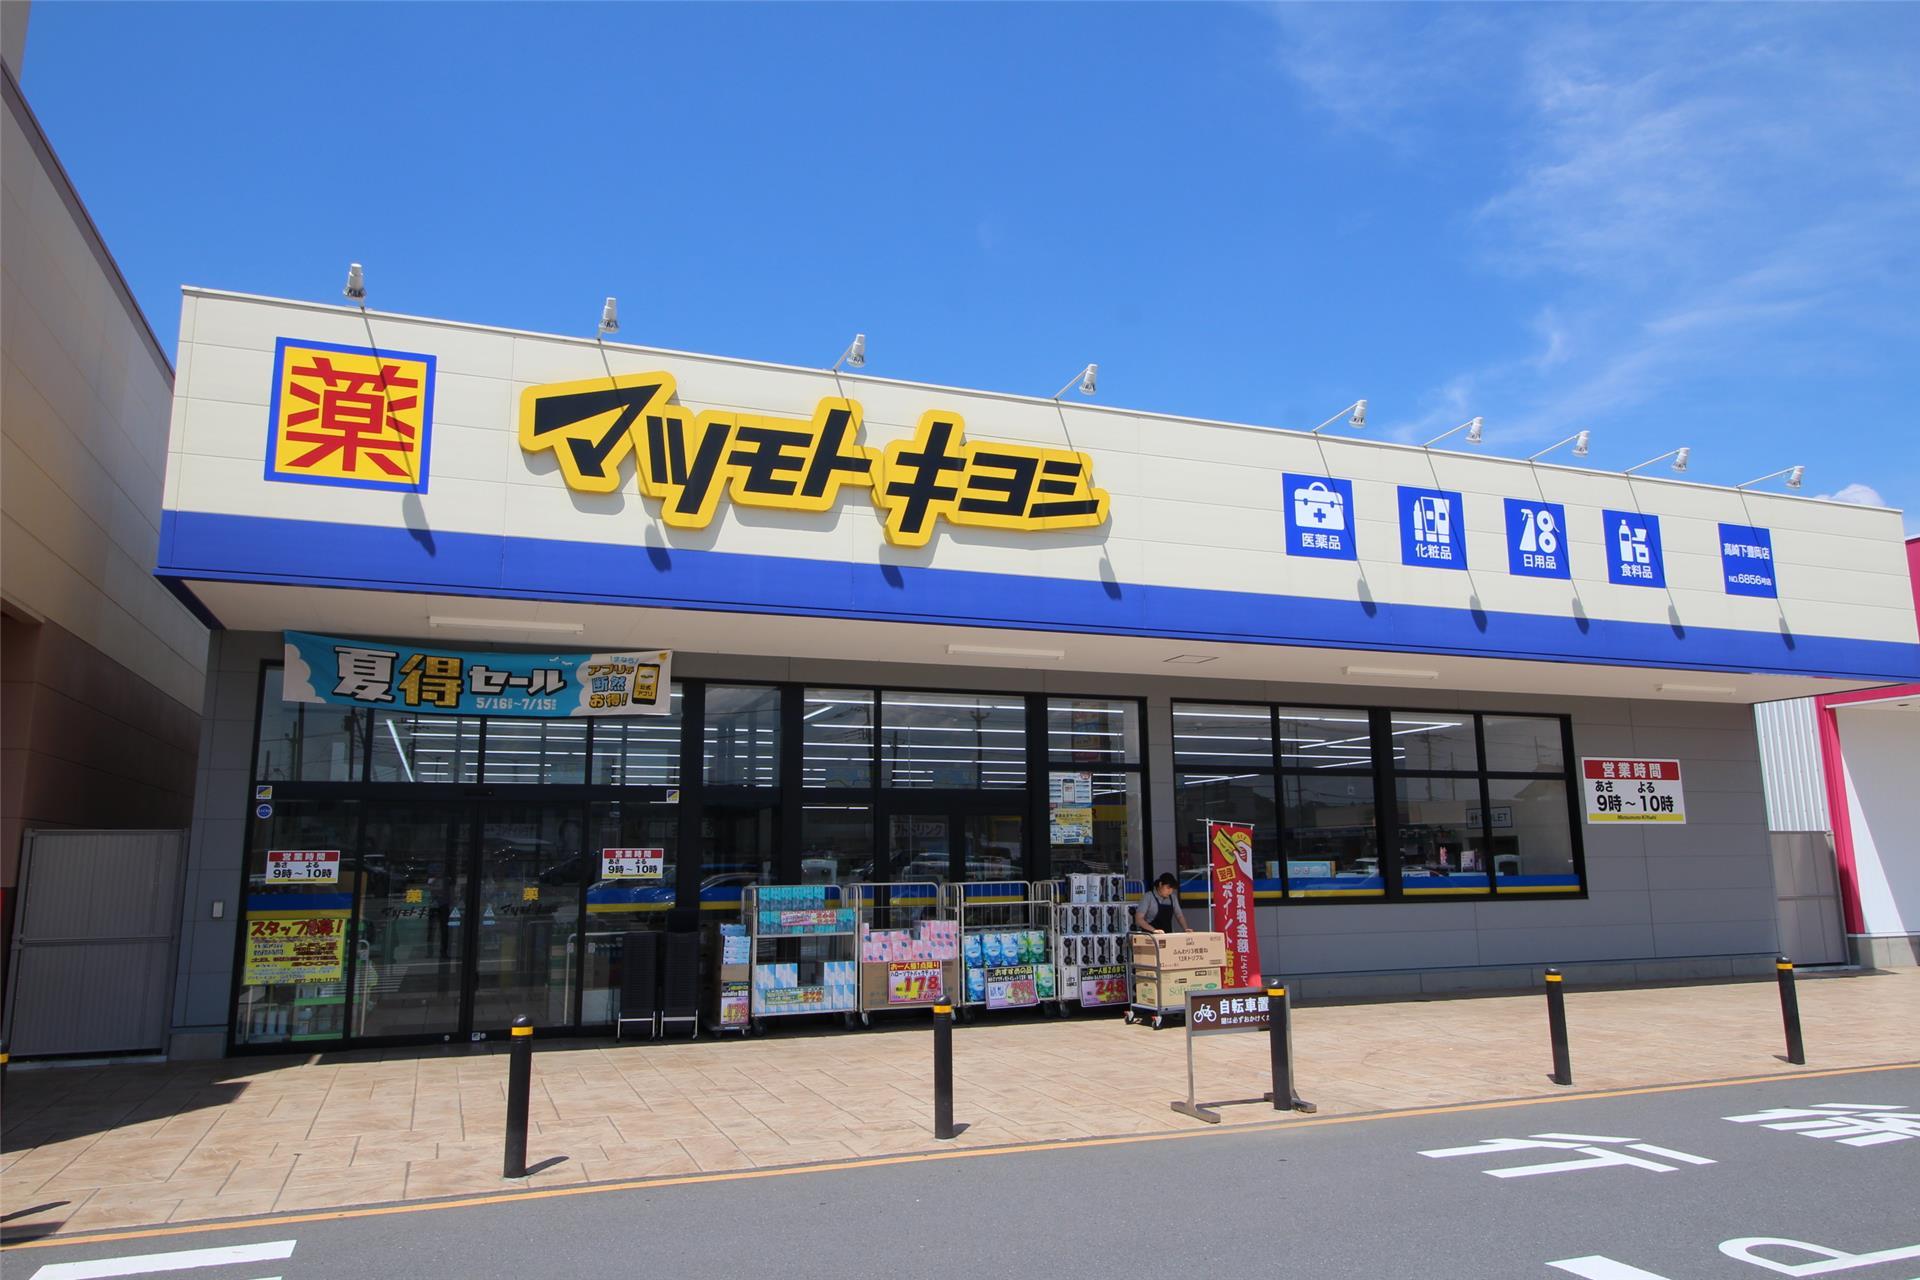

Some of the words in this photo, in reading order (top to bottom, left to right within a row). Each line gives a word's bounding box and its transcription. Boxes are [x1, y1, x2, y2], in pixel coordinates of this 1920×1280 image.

[286, 356, 418, 477] 薬
[533, 383, 1100, 533] マツモトキヨシ
[1302, 533, 1341, 550] 医薬品
[1415, 543, 1452, 560] 化粧品
[1523, 554, 1556, 569] 日用品
[1620, 564, 1653, 579] 食料品
[333, 646, 566, 707] 夏得セール
[592, 676, 627, 693] 断然
[1602, 762, 1662, 779] 営業時間
[1595, 780, 1614, 792] あさ
[1637, 782, 1655, 793] よる
[1220, 997, 1269, 1015] 自転車置
